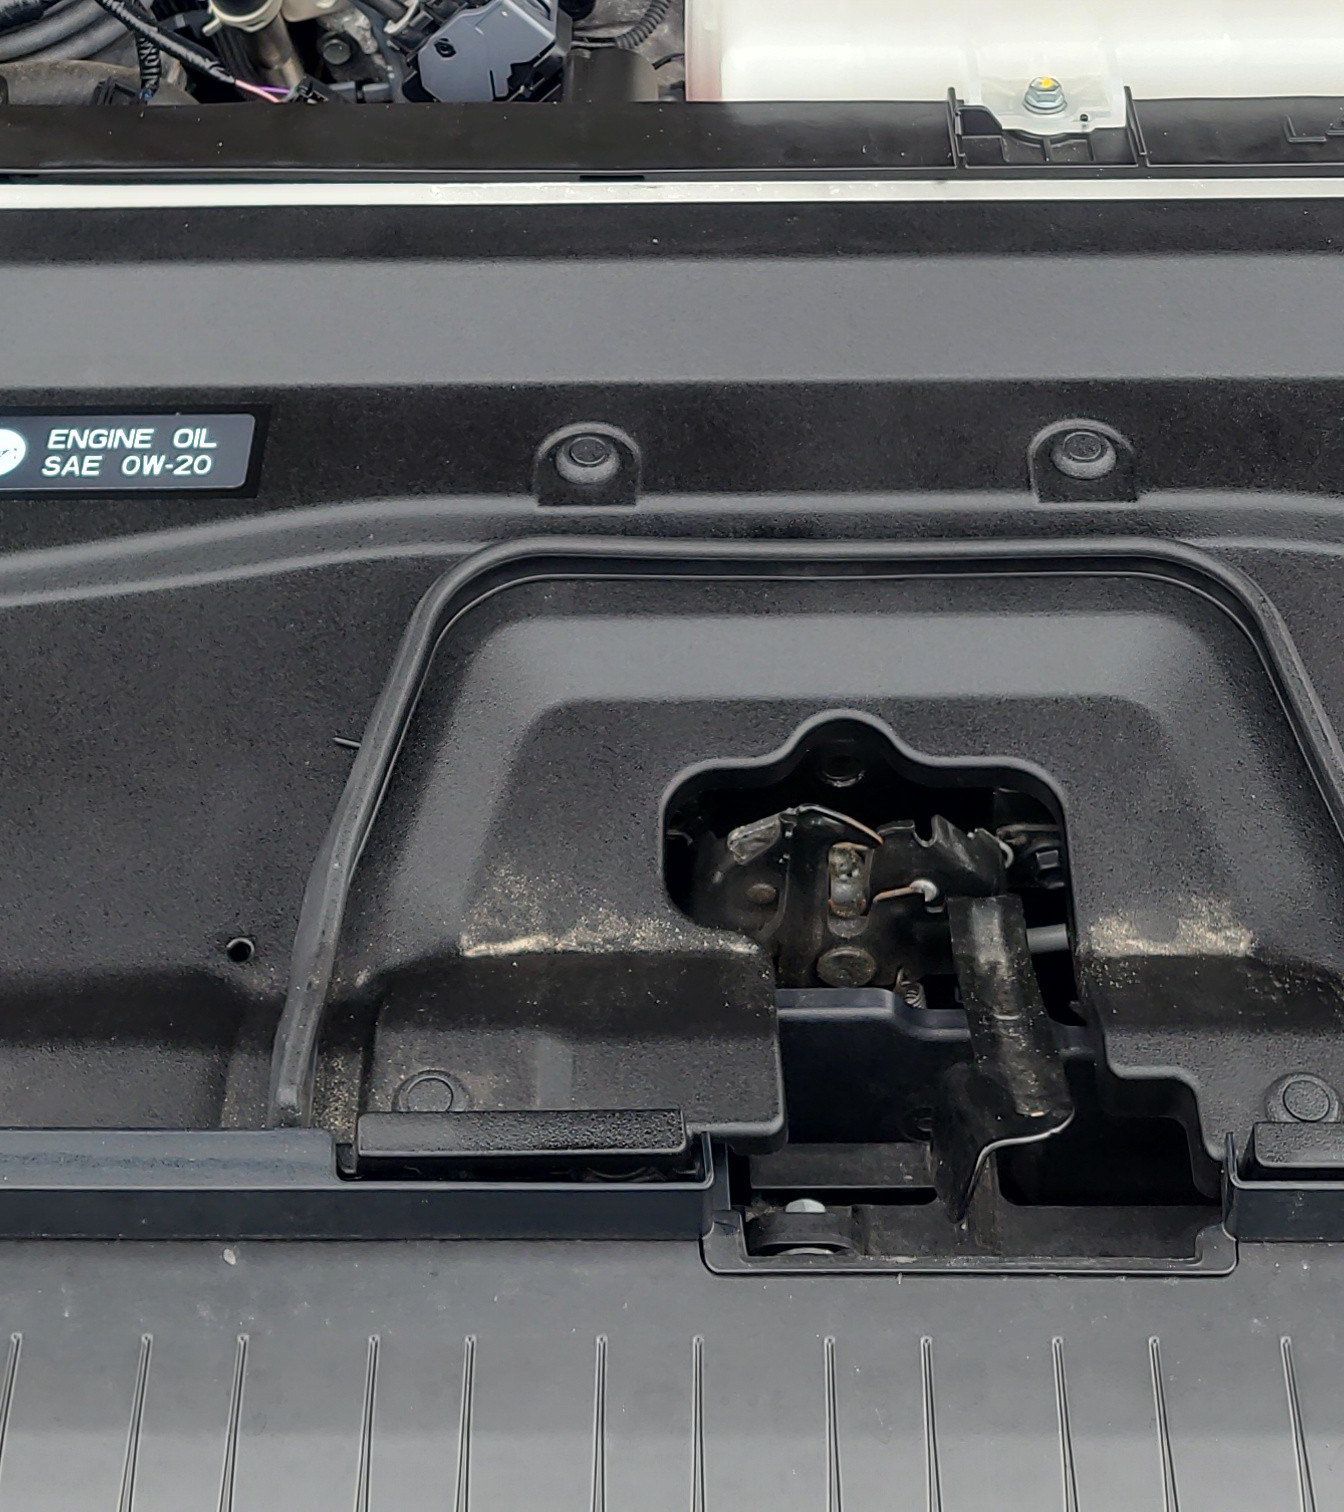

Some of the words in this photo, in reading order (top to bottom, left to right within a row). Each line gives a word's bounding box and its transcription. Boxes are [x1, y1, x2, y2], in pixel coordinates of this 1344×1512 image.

[47, 427, 156, 450] ENGINE
[172, 428, 219, 449] OIL
[41, 454, 102, 476] SAE
[121, 454, 213, 476] 0W-20
